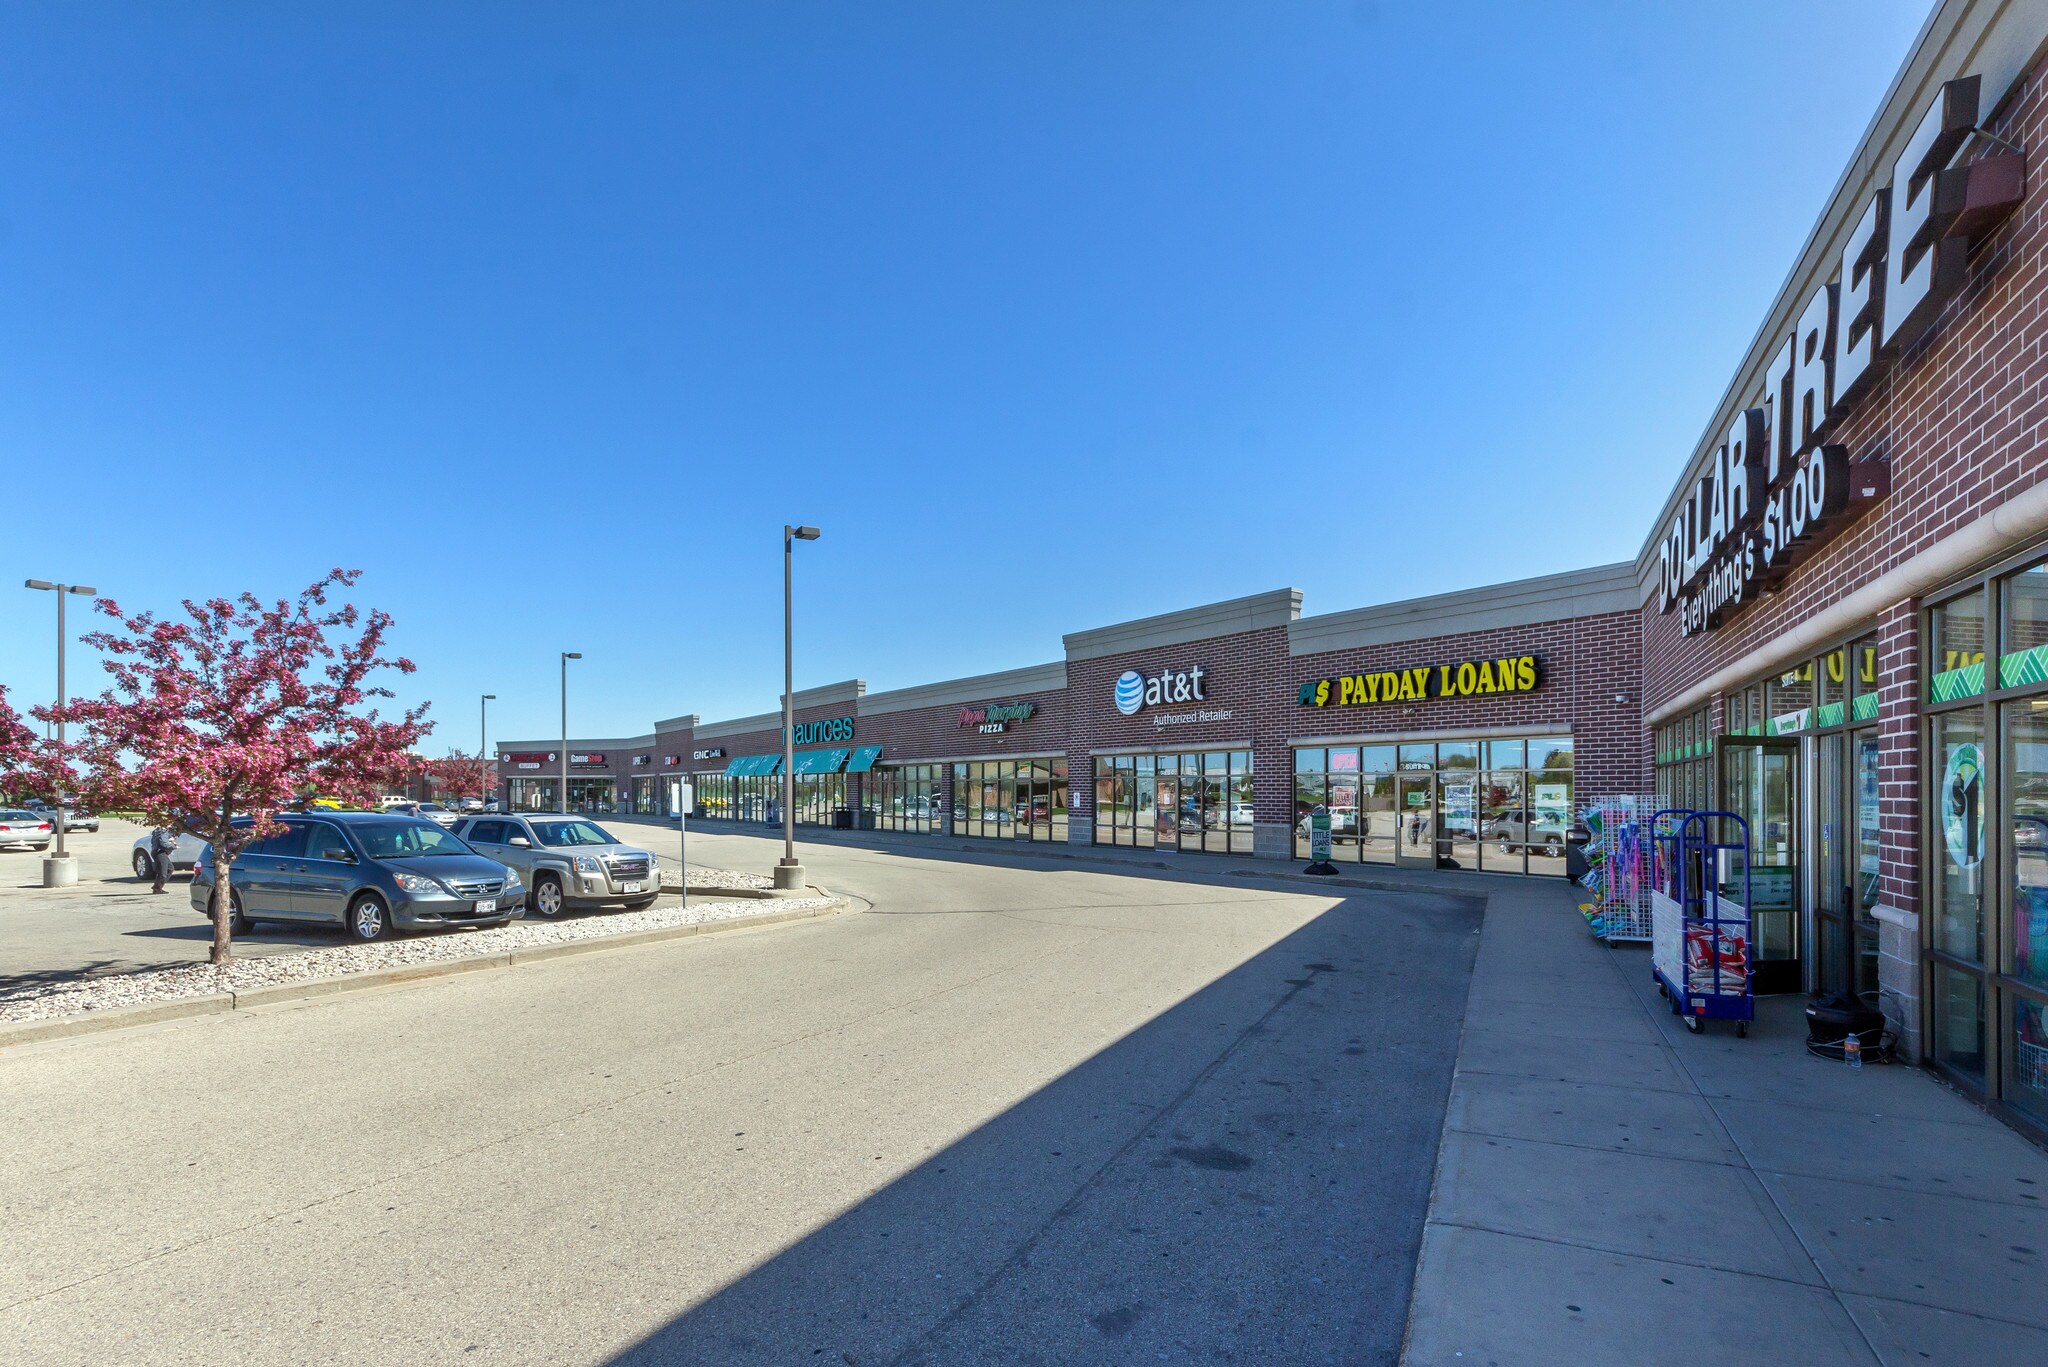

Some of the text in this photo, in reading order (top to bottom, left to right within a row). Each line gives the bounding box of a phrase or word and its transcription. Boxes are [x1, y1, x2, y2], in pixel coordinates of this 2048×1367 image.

[1659, 81, 1948, 615] DOLLAR TREE
[1681, 446, 1825, 638] Everything's $1.00
[1145, 664, 1205, 706] at&t
[1339, 667, 1431, 706] PAYDAY
[1440, 655, 1537, 697] LOANS
[956, 706, 986, 729] Papa
[1153, 708, 1233, 725] Authorized Retailer
[979, 723, 1003, 734] PIZZA
[570, 754, 603, 763] GameStop
[693, 750, 709, 760] GNC
[1333, 753, 1357, 769] OPEN
[1312, 831, 1330, 839] TITLE
[1312, 839, 1330, 847] LOANS
[620, 863, 640, 871] GMC
